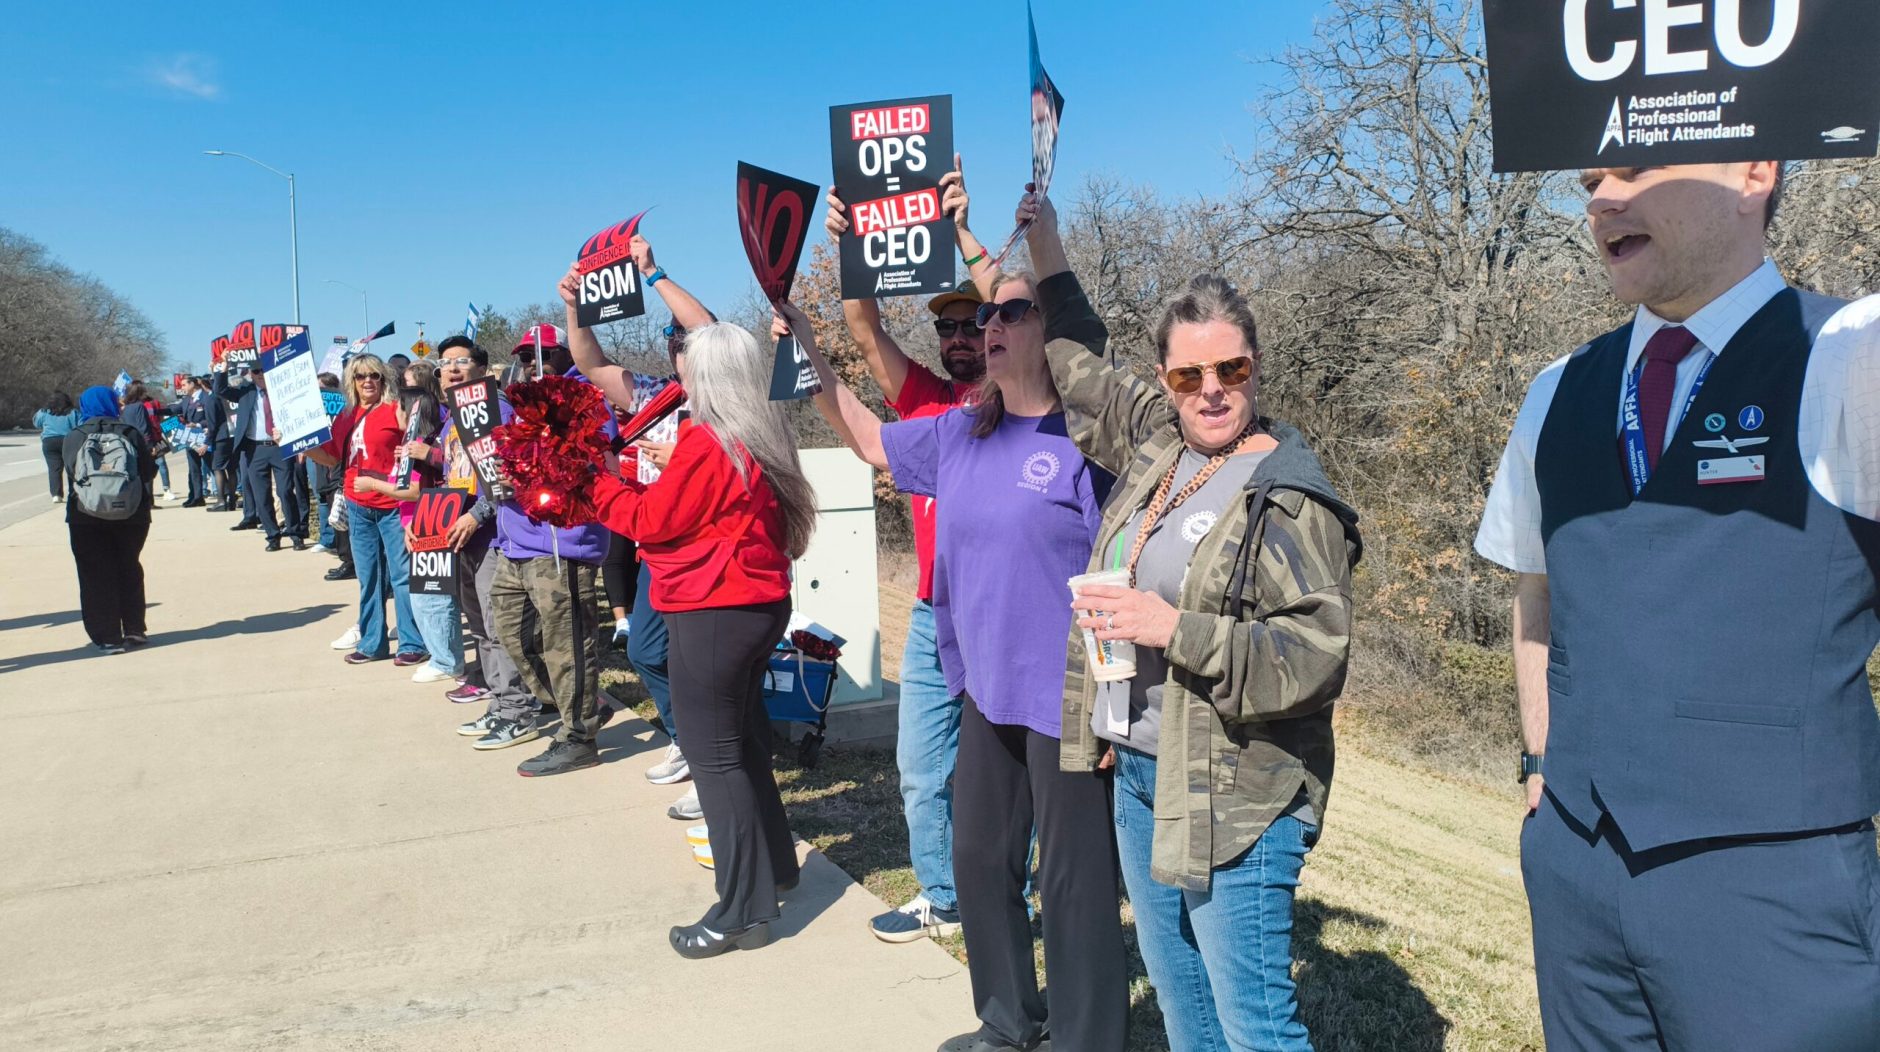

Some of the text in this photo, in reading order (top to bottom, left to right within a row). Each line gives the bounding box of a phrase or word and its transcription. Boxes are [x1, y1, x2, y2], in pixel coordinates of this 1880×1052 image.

[1563, 0, 1800, 81] CEO
[1628, 86, 1738, 110] Association of
[853, 107, 926, 137] FAILED
[1628, 107, 1721, 127] Professional
[1627, 123, 1755, 146] Flight Attendants
[858, 134, 927, 176] OPS
[854, 192, 935, 233] FAILED
[863, 225, 931, 268] CEO
[580, 262, 636, 305] ISOM
[261, 326, 283, 347] NO
[227, 349, 257, 362] SOM
[454, 385, 486, 406] FAILED
[460, 401, 489, 429] OPS
[1625, 391, 1640, 430] APFA
[292, 436, 320, 452] APFA.org
[414, 492, 462, 536] NO
[412, 552, 452, 577] ISOM
